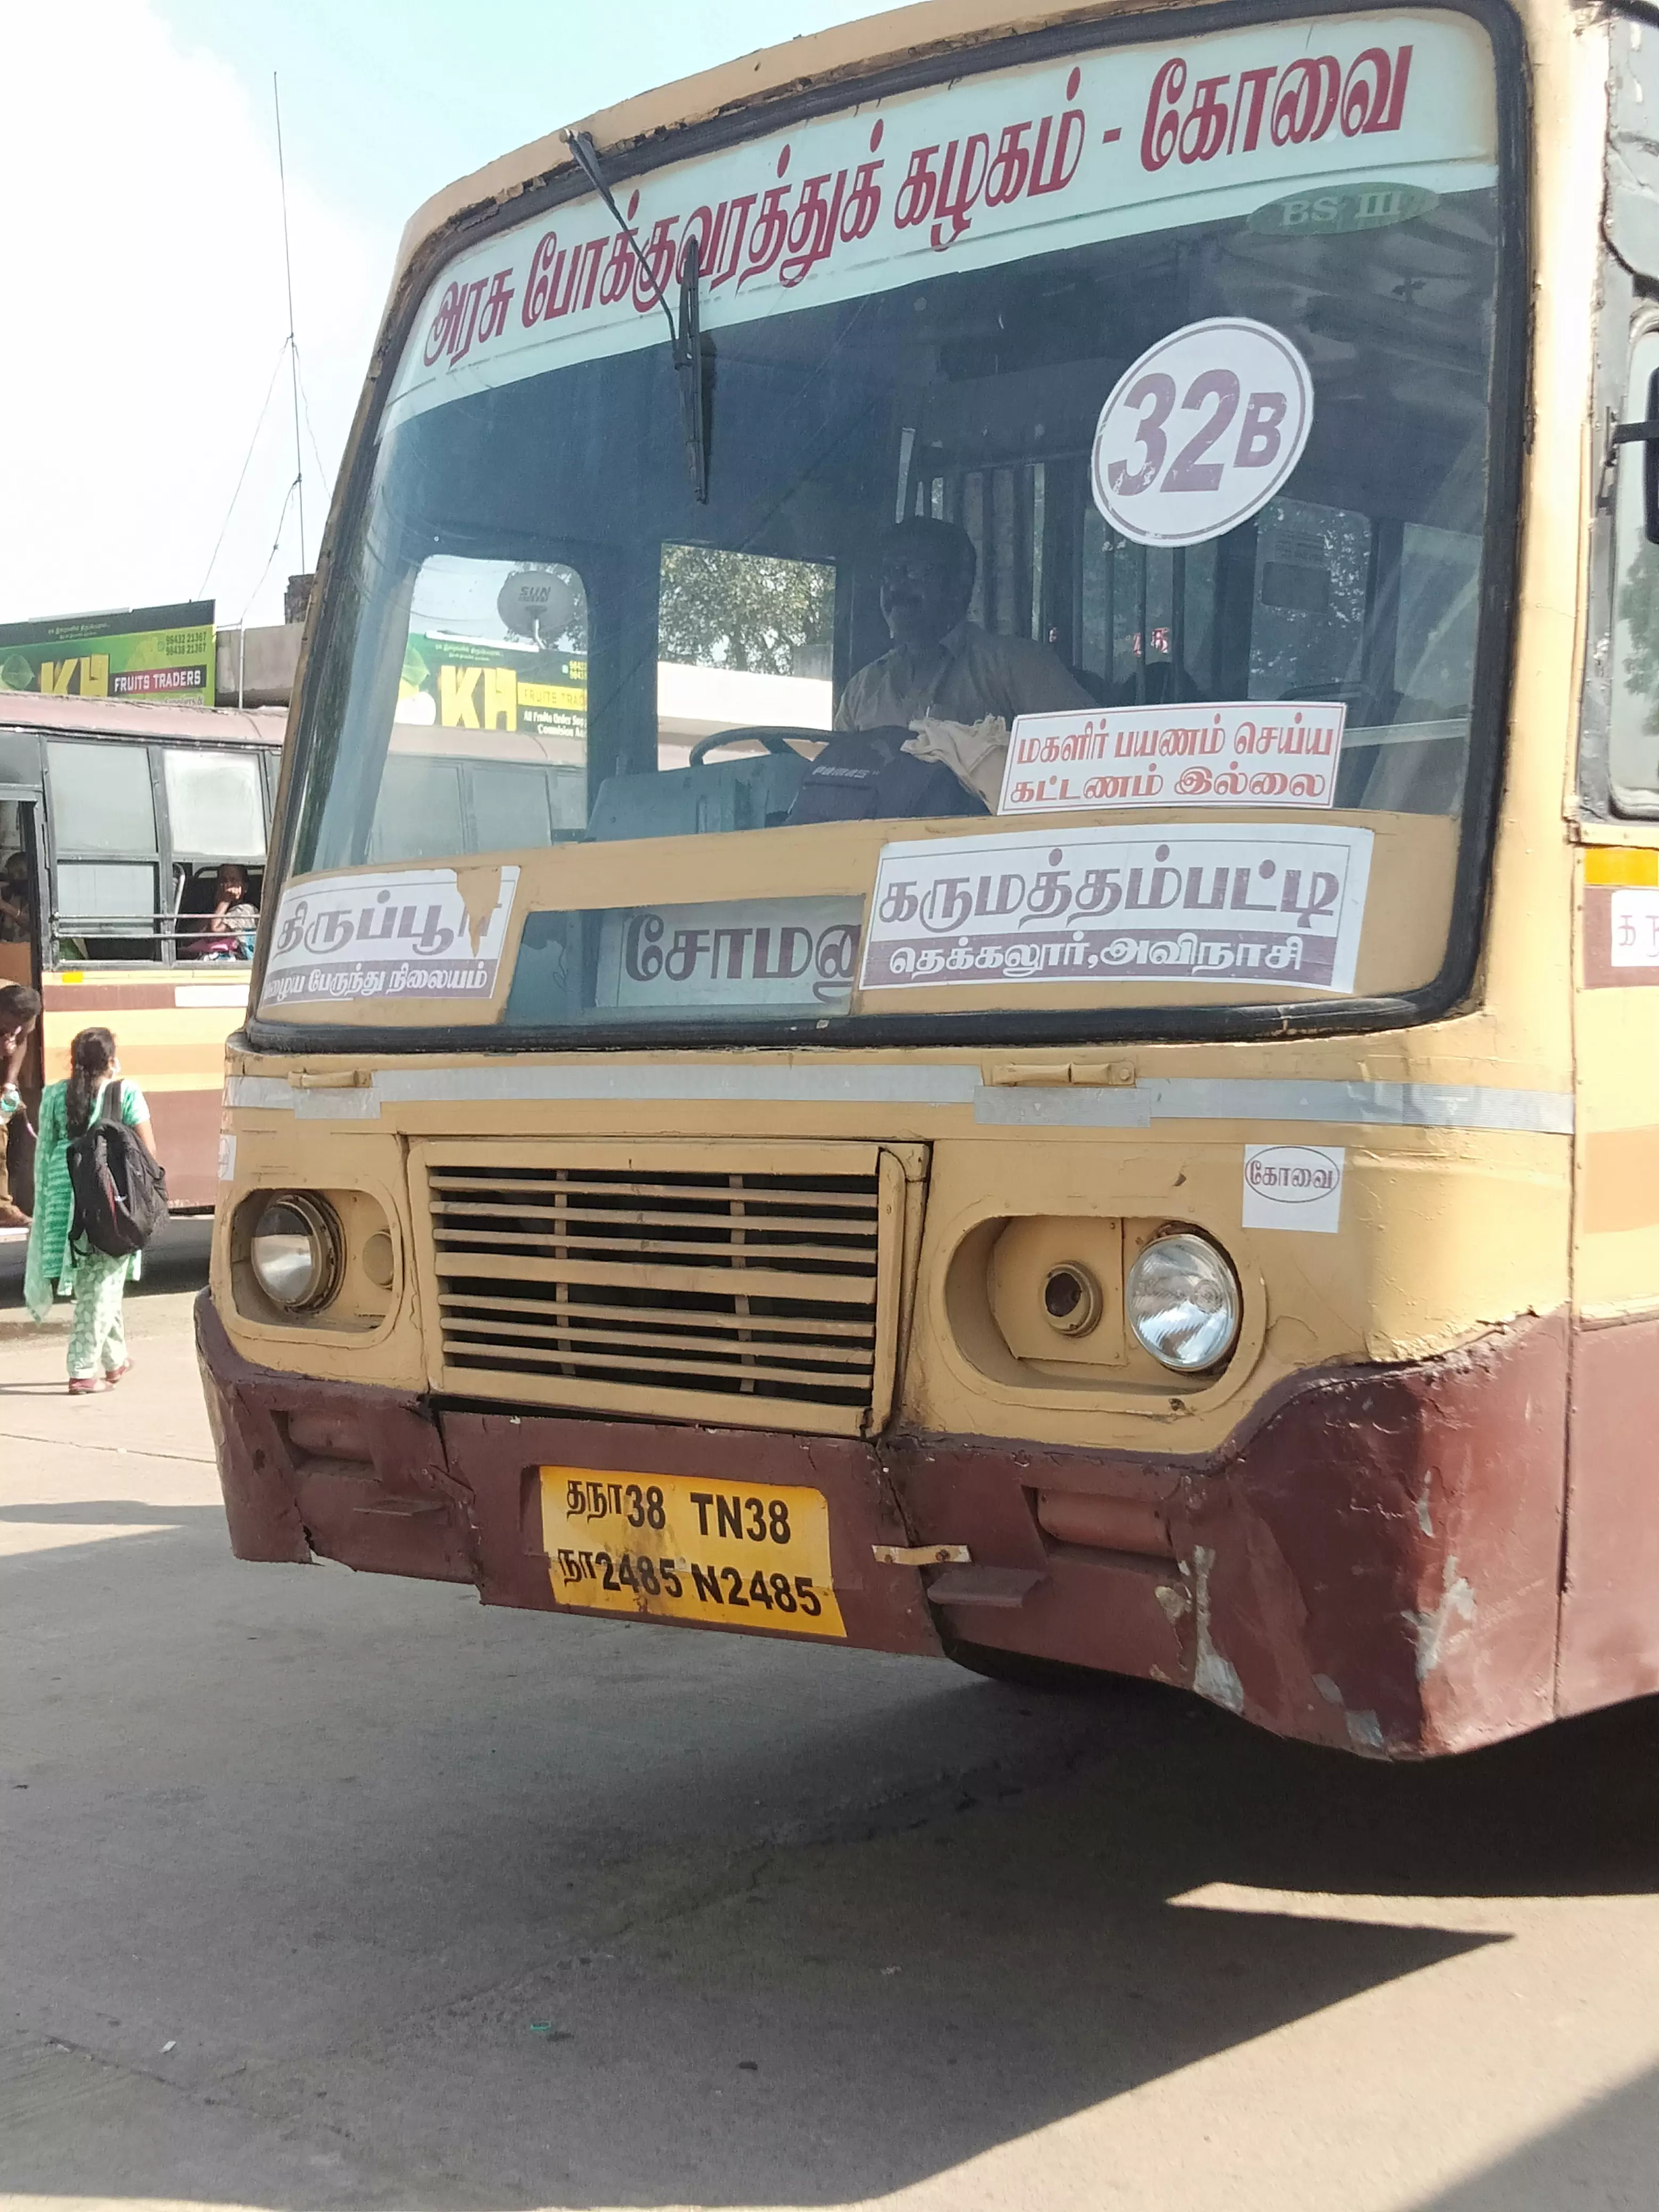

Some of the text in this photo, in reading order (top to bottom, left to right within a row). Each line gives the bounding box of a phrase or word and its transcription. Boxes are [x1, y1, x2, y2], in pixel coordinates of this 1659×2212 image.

[424, 267, 515, 368] அரசு
[522, 118, 885, 328] போக்குவரத்துக்
[894, 66, 1085, 252] கழகம்
[1141, 45, 1413, 172] கோவை
[1282, 190, 1402, 226] BS III
[1108, 369, 1287, 496] 32B
[41, 654, 109, 697] KH
[114, 669, 201, 692] FRUITS TRADERS
[440, 665, 517, 732] KH
[1017, 711, 1334, 764] மகளிர் பயணம் செய்ய
[1010, 760, 1326, 803] கட்டணம் இல்லை
[878, 844, 1339, 932] கருமத்தம்பட்டி
[308, 962, 385, 996] பேருந்து
[386, 960, 488, 994] நிலையம்
[1250, 1160, 1333, 1189] கோவை
[690, 1492, 791, 1544] TN38
[691, 1563, 822, 1616] N2485
